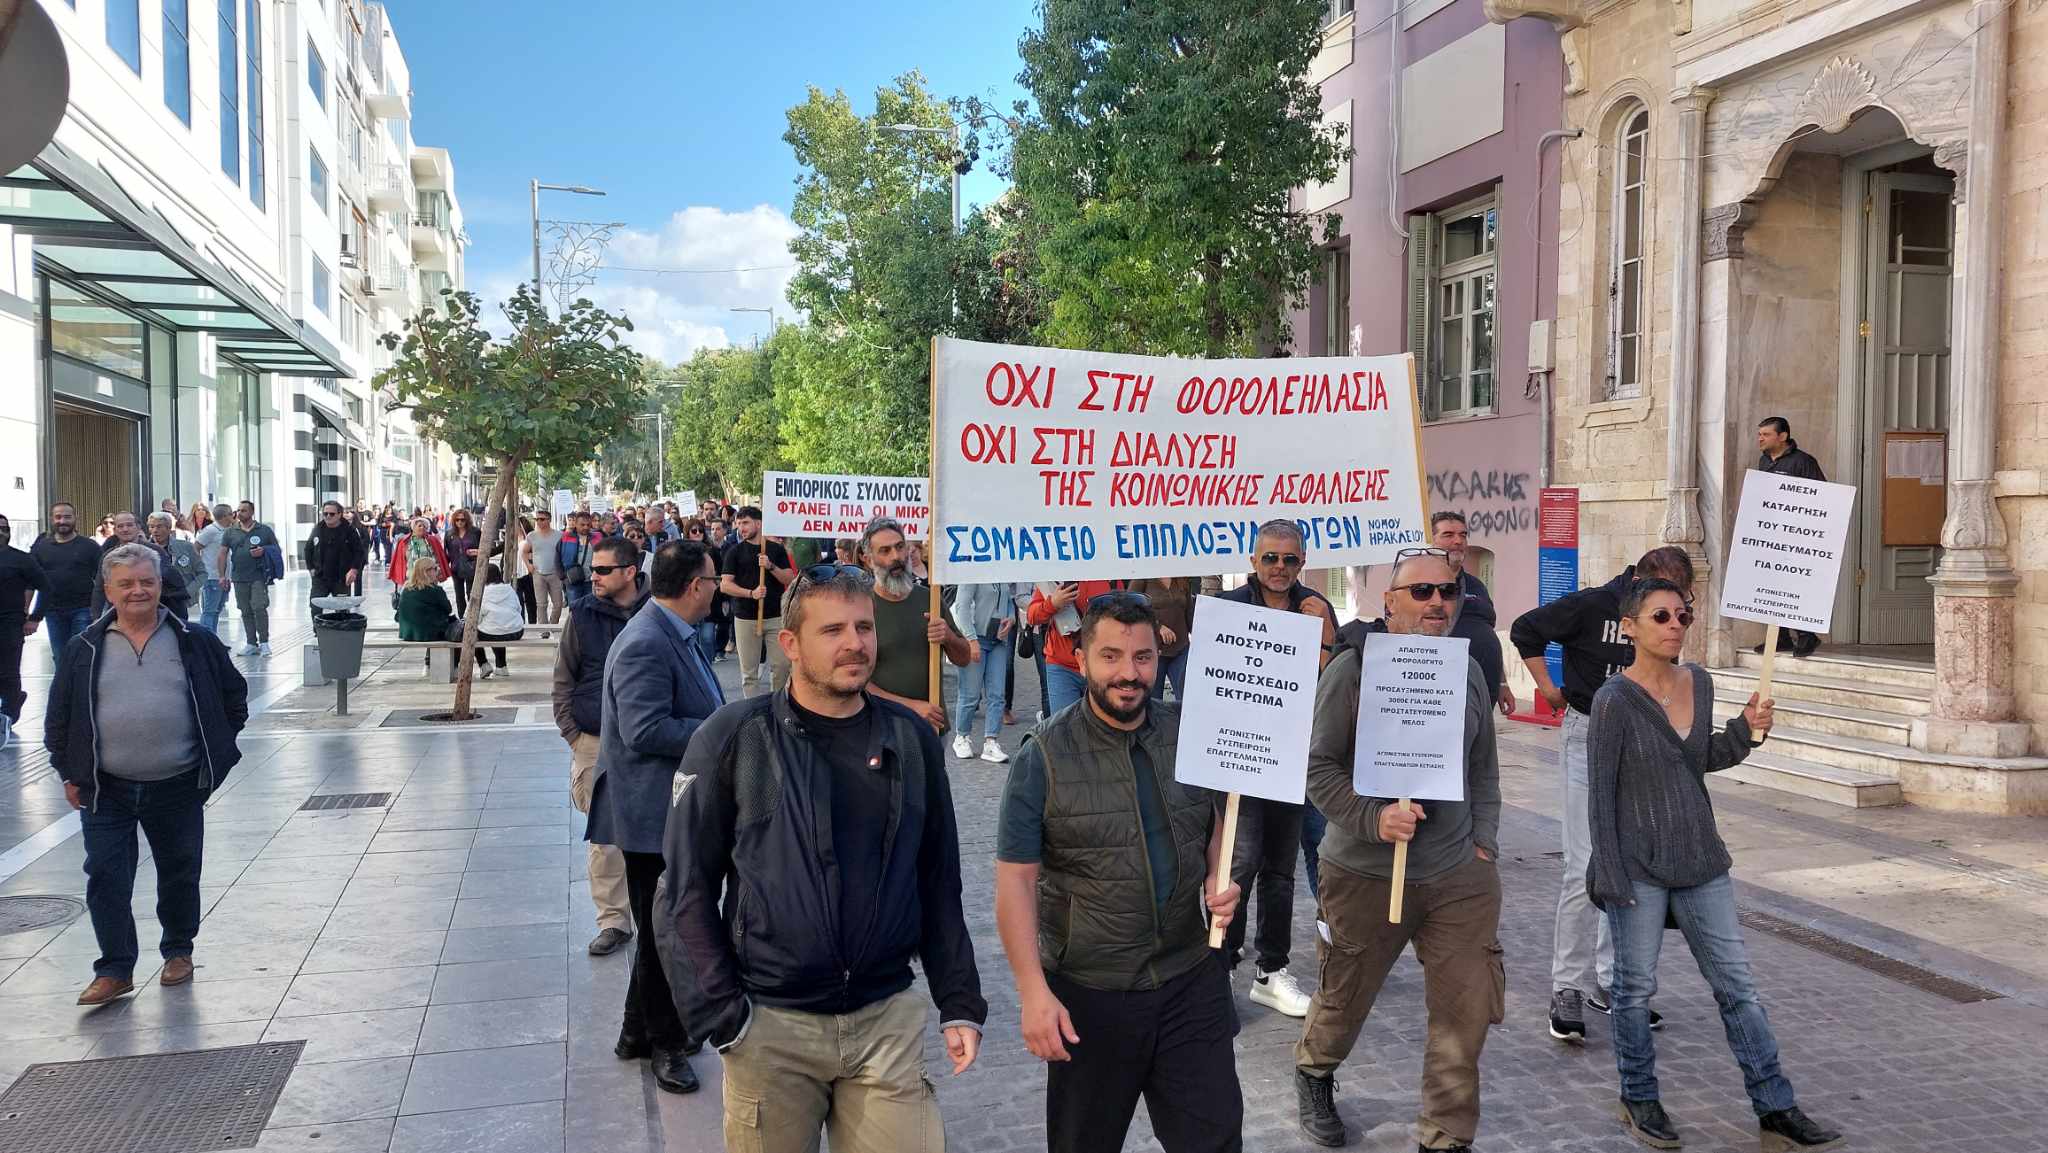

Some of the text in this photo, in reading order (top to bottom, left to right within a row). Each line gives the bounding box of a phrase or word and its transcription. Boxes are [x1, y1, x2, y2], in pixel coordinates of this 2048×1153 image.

[985, 361, 1389, 416] ΟΧΙ ΣΤΗ ΦΟΡΟΛΕΗΛΑΣΙΑ
[960, 423, 1237, 469] ΟΧΙ ΣΤΗ ΔΙΑΛΥΣΗ
[775, 477, 922, 502] ΕΜΠΟΡΙΚΟΣ ΣΥΛΛΟΓΟΣ
[1039, 469, 1390, 507] ΤΗΣ ΚΟΙΝΩΝΙΚΗΣ ΑΣΦΑΛΙΣΗΣ
[1778, 482, 1818, 496] ΑΜΕΣΗ
[777, 501, 831, 516] ΦΤΑΝΕΙ
[840, 504, 864, 517] ΠΙΑ
[872, 505, 887, 517] ΟΙ
[1762, 500, 1828, 519] ΚΑΤΑΡΓΗΣΗ
[803, 520, 833, 532] ΔΕΝ
[1368, 518, 1400, 531] ΝΟΜΟΥ
[1757, 520, 1826, 539] ΤΟΥ ΤΕΛΟΥΣ
[946, 524, 1096, 563] ΣΩΜΑΤΕΙΟ
[1369, 530, 1424, 545] ΗΡΑΚΛΕΙΟΥ
[1741, 537, 1834, 560] ΕΠΙΤΗΔΕΥΜΑΤΟΣ
[1754, 559, 1813, 577] ΓΙΑ ΟΛΟΥΣ
[1755, 587, 1801, 600] ΑΓΩΝΙΣΤΙΚΗ
[1726, 602, 1825, 625] ΕΠΑΓΓΕΛΜΑΤΙΩΝ ΕΣΤΙΑΣΗΣ
[1248, 621, 1268, 633] ΝΑ
[1215, 633, 1297, 656] ΑΠΟΣΥΡΘΕΙ
[1398, 647, 1439, 655] ΑΠΑΙΤΟΥΜΕ
[1244, 655, 1264, 668] ΤΟ
[1391, 657, 1444, 666] ΑΦΟΡΟΛΟΓΗΤΟ
[1204, 666, 1299, 692] ΝΟΜΟΣΧΕΔΙΟ
[1401, 671, 1437, 681] 12000€
[1215, 687, 1284, 708] ΕΚΤΡΩΜΑ
[1436, 688, 1454, 696] ΚΑΤΑ
[1401, 719, 1426, 727] ΜΕΛΟΣ
[1218, 727, 1271, 742] ΑΓΩΝΙΣΤΙΚΗ
[1216, 738, 1271, 753] ΣΥΣΠΕΙΡΩΣΗ
[1206, 747, 1279, 766] ΕΠΑΓΓΕΛΜΑΤΙΩΝ
[1220, 761, 1263, 774] ΕΣΤΙΑΣΗΣ
